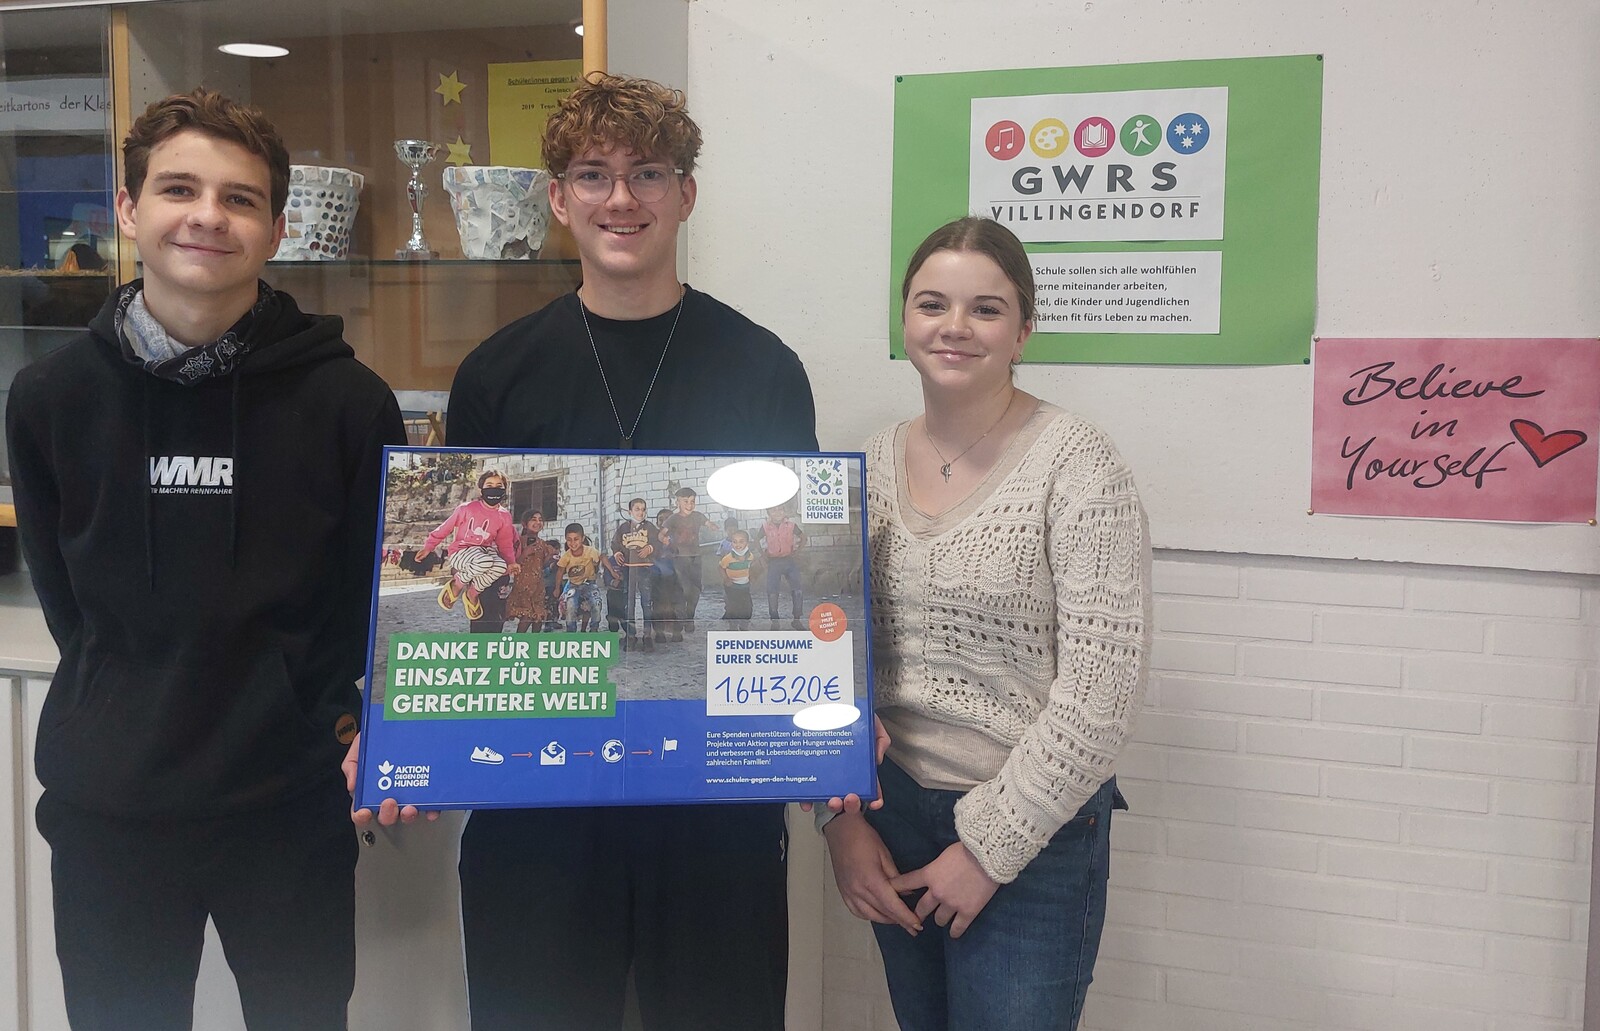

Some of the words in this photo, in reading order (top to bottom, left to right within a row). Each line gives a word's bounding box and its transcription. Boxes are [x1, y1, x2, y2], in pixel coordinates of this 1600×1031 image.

[60, 95, 80, 110] der
[1012, 162, 1177, 195] GWRS
[991, 202, 1200, 221] VILLINGENDORF
[1035, 266, 1066, 275] Schule
[1069, 266, 1096, 275] sollen
[1099, 266, 1118, 275] sich
[1120, 266, 1138, 274] alle
[1140, 265, 1197, 274] wohlfühlen
[1062, 282, 1120, 291] miteinander
[1123, 282, 1168, 292] arbeiten,
[1054, 298, 1068, 306] die
[1071, 298, 1102, 306] Kinder
[1105, 298, 1123, 306] und
[1125, 298, 1190, 307] Jugendlichen
[1071, 313, 1081, 322] fit
[1084, 313, 1102, 322] fürs
[1105, 313, 1133, 322] Leben
[1150, 313, 1192, 322] machen.
[1342, 362, 1545, 406] Believe
[1411, 410, 1458, 440] in
[150, 456, 233, 486] WMR
[1341, 436, 1515, 490] Yourself
[806, 498, 844, 506] SCHULEN
[397, 642, 479, 660] DANKE
[486, 636, 530, 659] FÜR
[538, 641, 610, 659] EUREN
[716, 640, 813, 650] SPENDENSUMME
[716, 654, 751, 664] EURER
[756, 654, 798, 664] SCHULE
[395, 667, 491, 686] EINSATZ
[499, 662, 542, 685] FÜR
[550, 666, 599, 685] EINE
[715, 676, 841, 705] 1.643,20€
[392, 693, 535, 713] GERECHTERE
[542, 692, 607, 711] WELT!
[395, 765, 430, 774] AKTION
[706, 776, 817, 784] www.schulen-gegen-den-hunger.de
